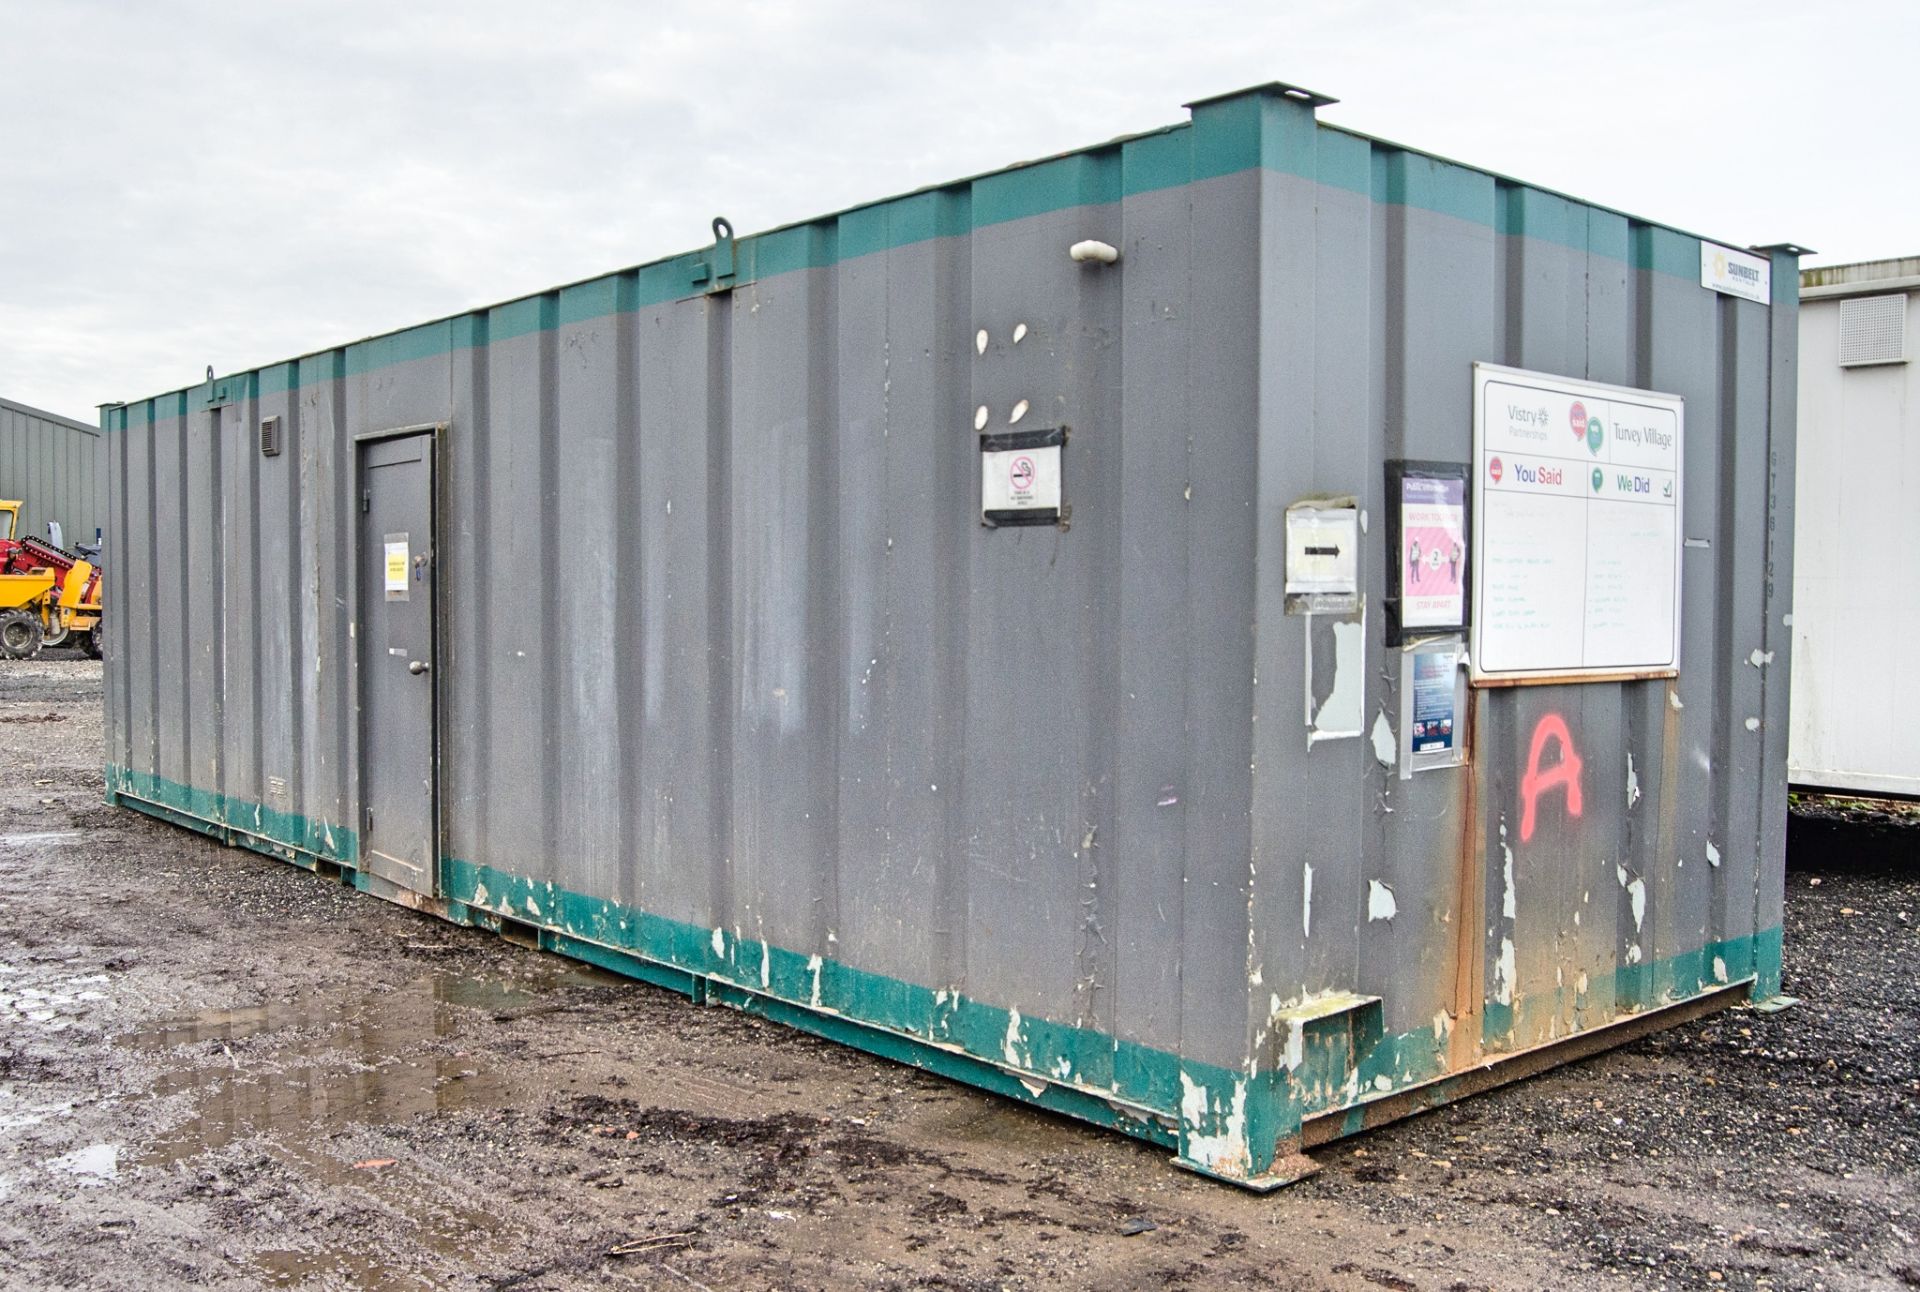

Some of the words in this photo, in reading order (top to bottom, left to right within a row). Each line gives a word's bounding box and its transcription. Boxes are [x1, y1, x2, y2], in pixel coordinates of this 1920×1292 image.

[1728, 262, 1759, 282] SUNBELT
[1507, 404, 1538, 426] Vistry
[1613, 422, 1641, 447] Turvey
[1643, 427, 1672, 450] Village
[1514, 463, 1536, 484] You
[1538, 466, 1563, 486] Said
[1617, 474, 1633, 492] We
[1634, 476, 1650, 493] Did
[1433, 551, 1439, 561] 2
[1416, 600, 1431, 609] STAY
[1432, 599, 1452, 609] APART
[1520, 712, 1583, 843] A
